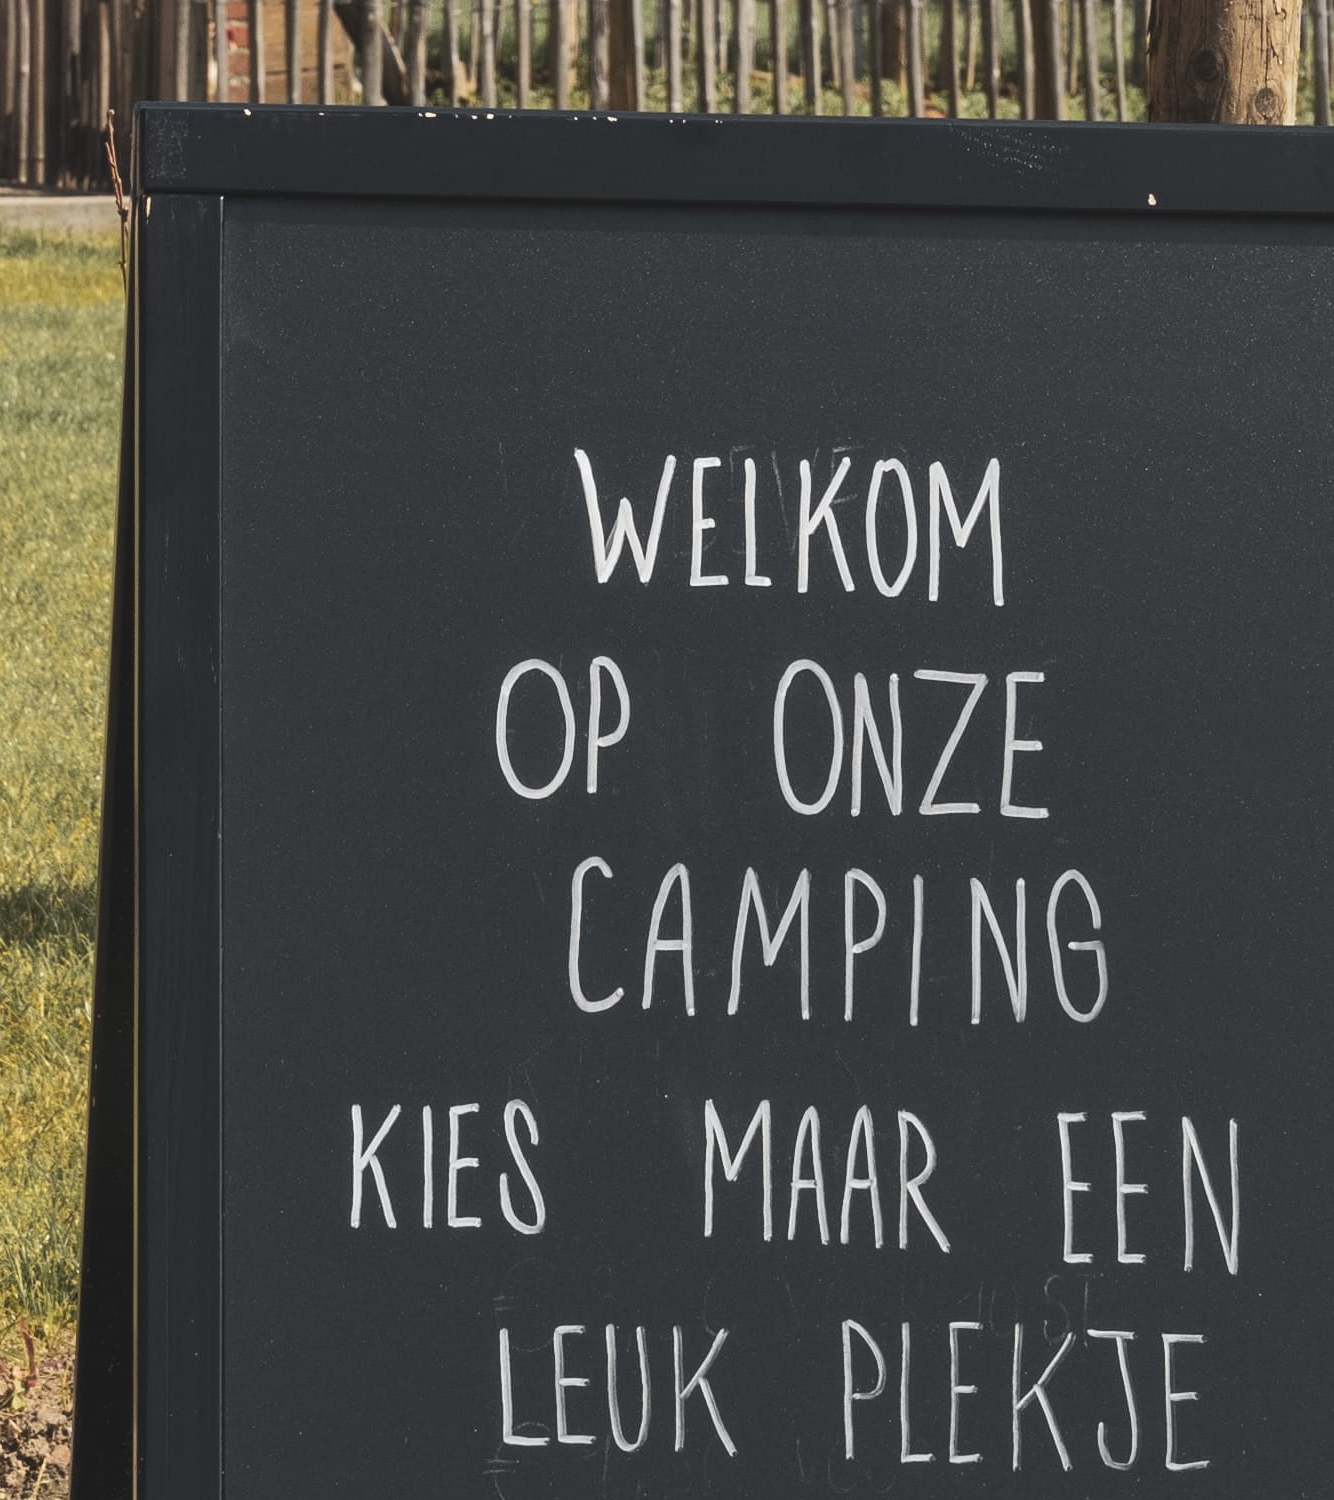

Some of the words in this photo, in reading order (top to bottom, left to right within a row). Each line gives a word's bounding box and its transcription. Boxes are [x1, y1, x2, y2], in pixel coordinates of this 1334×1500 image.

[574, 447, 1004, 606] WELKOM
[496, 656, 631, 799] OP
[773, 659, 1049, 819] ONZE
[568, 856, 1108, 1026] CAMPING
[350, 1098, 546, 1235] KIES
[703, 1098, 951, 1253] MAAR
[1058, 1110, 1240, 1275] EEN
[499, 1324, 738, 1457] LEUK
[841, 1318, 1209, 1472] PLEKJE
